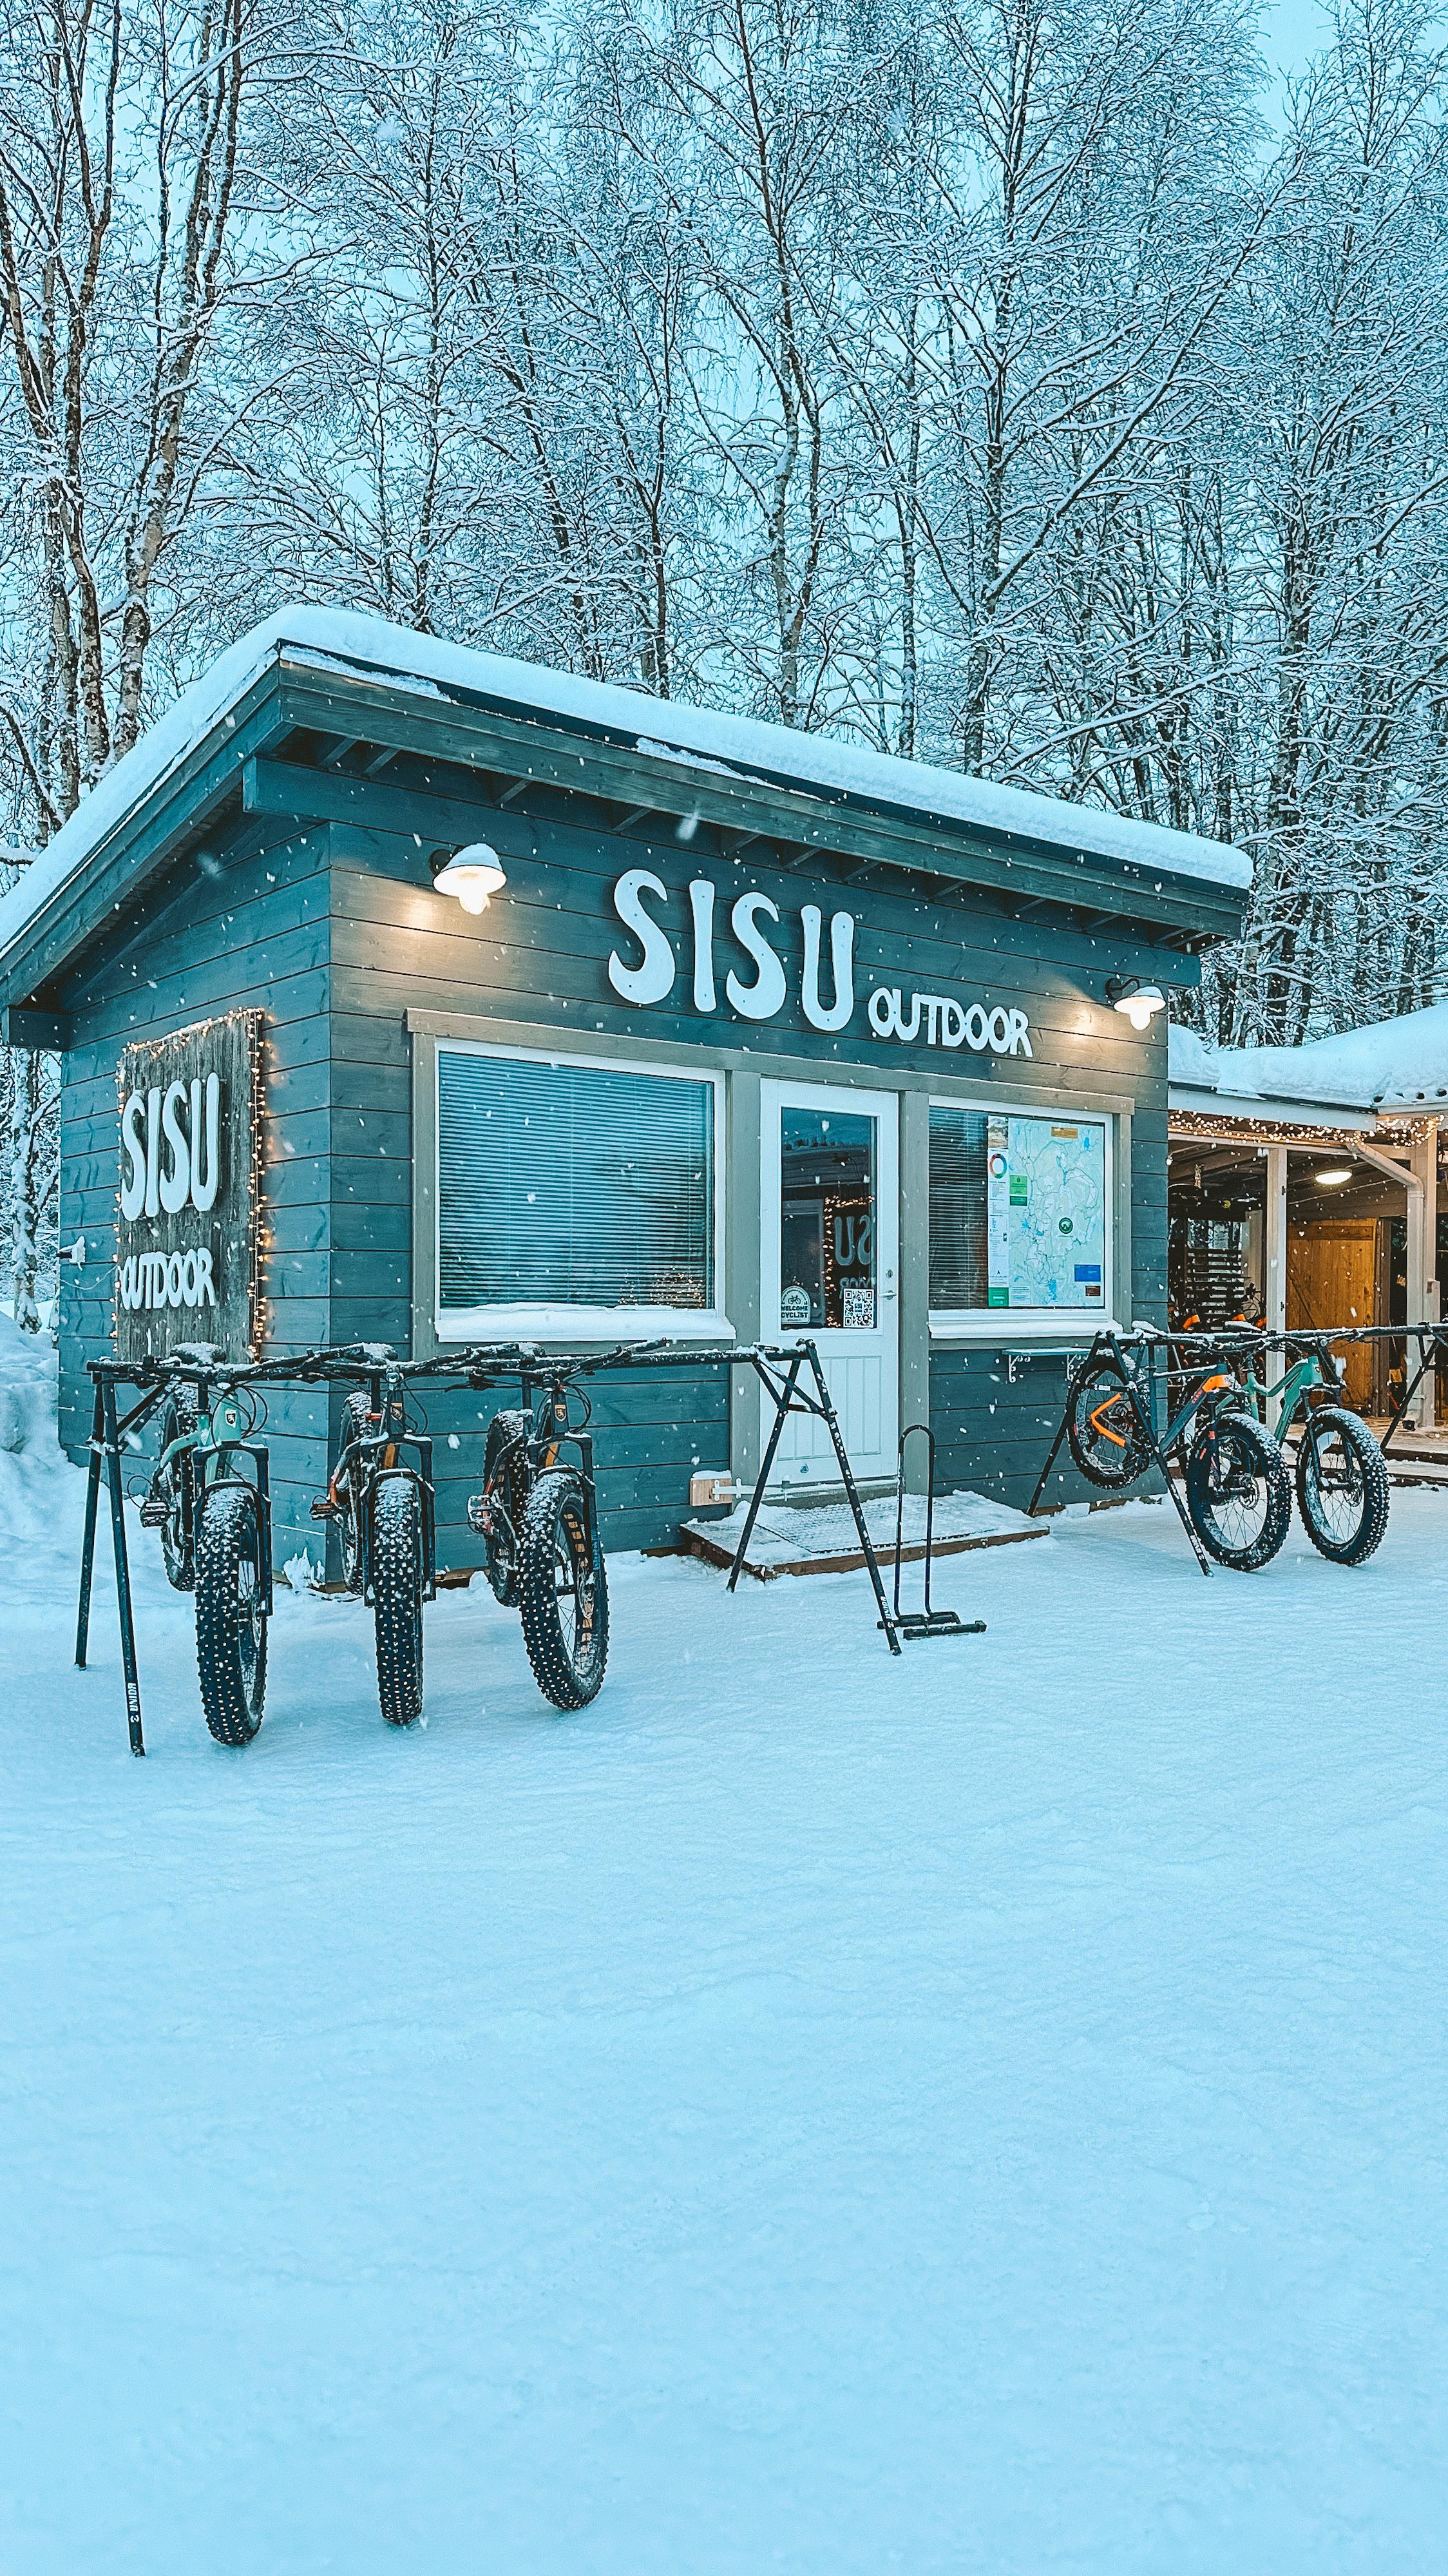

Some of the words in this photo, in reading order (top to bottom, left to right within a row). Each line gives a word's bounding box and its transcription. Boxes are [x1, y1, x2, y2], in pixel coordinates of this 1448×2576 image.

[608, 869, 855, 1031] SISU
[868, 986, 1033, 1058] OUTDOOR
[120, 1072, 220, 1221] SISU
[120, 1247, 216, 1310] OUTDOOR
